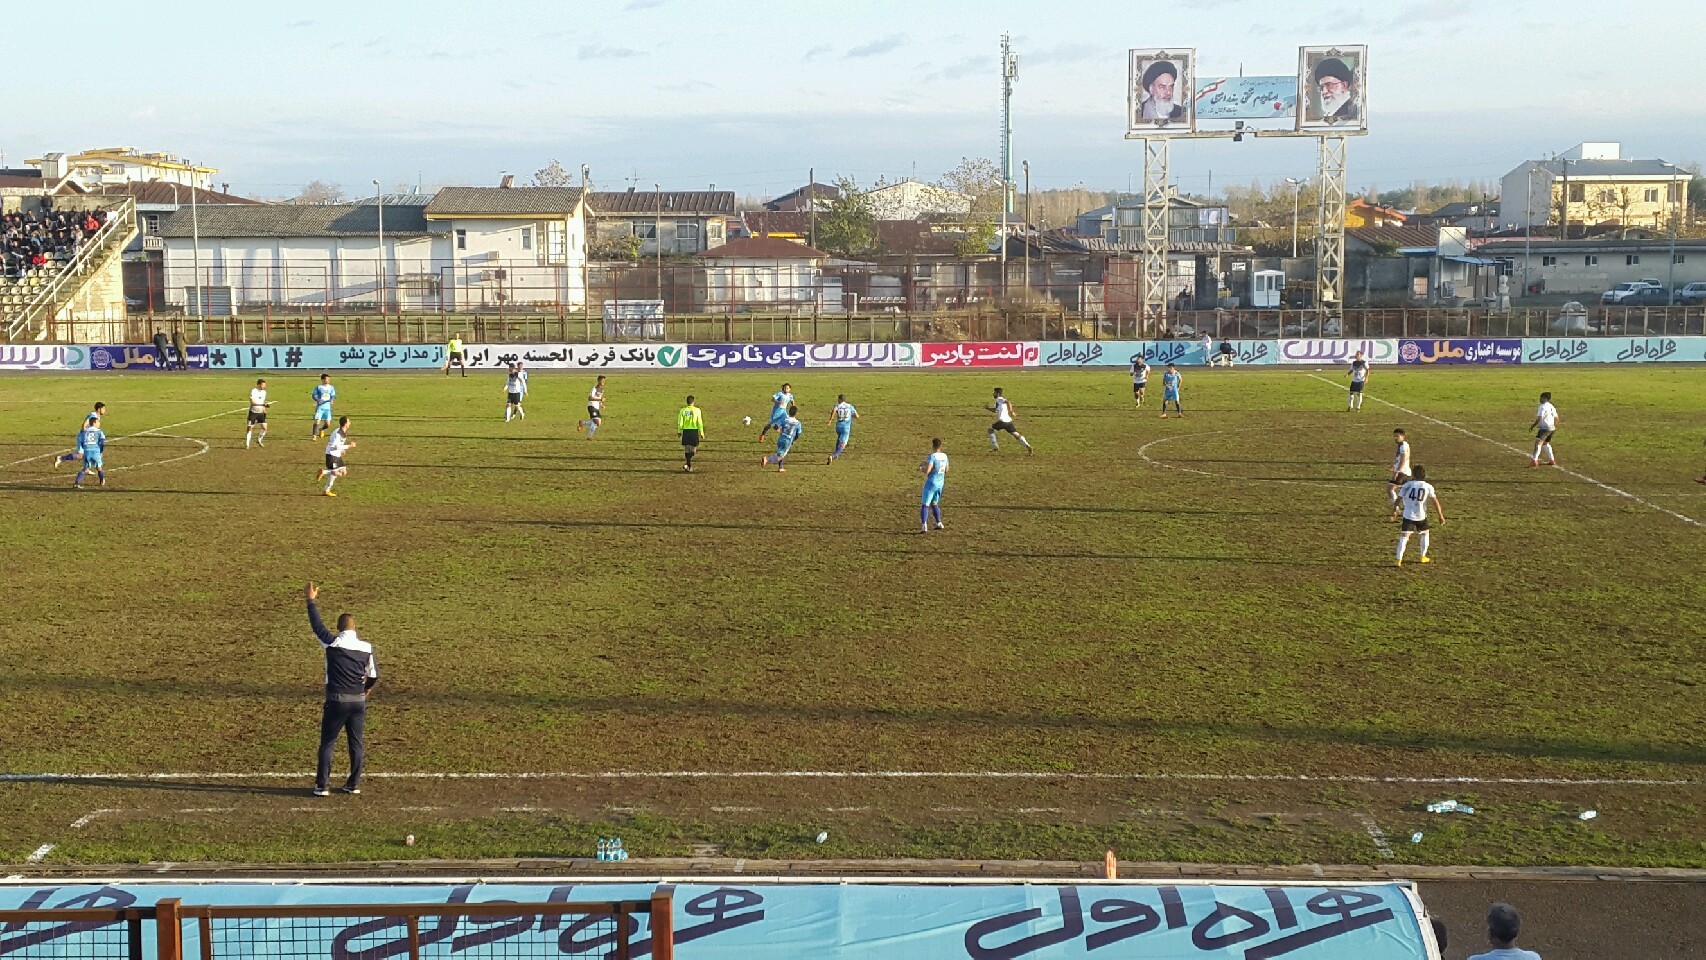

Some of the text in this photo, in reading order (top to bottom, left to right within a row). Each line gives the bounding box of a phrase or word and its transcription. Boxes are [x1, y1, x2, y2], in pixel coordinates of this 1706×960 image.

[111, 346, 155, 369] ملل
[340, 346, 365, 364] نشو
[368, 347, 397, 368] خارج
[400, 347, 429, 363] مدار
[431, 346, 443, 362] از
[493, 352, 518, 367] مهر
[523, 347, 573, 361] الحسنه
[578, 347, 616, 366] قرض
[620, 347, 655, 365] بانک
[688, 345, 804, 368] چای نادری
[922, 344, 1023, 366] لنت پارس
[1047, 343, 1076, 364] اول
[1420, 341, 1465, 363] ملل
[1529, 340, 1560, 361] اول
[1617, 339, 1649, 360] اول
[1409, 487, 1425, 501] 40
